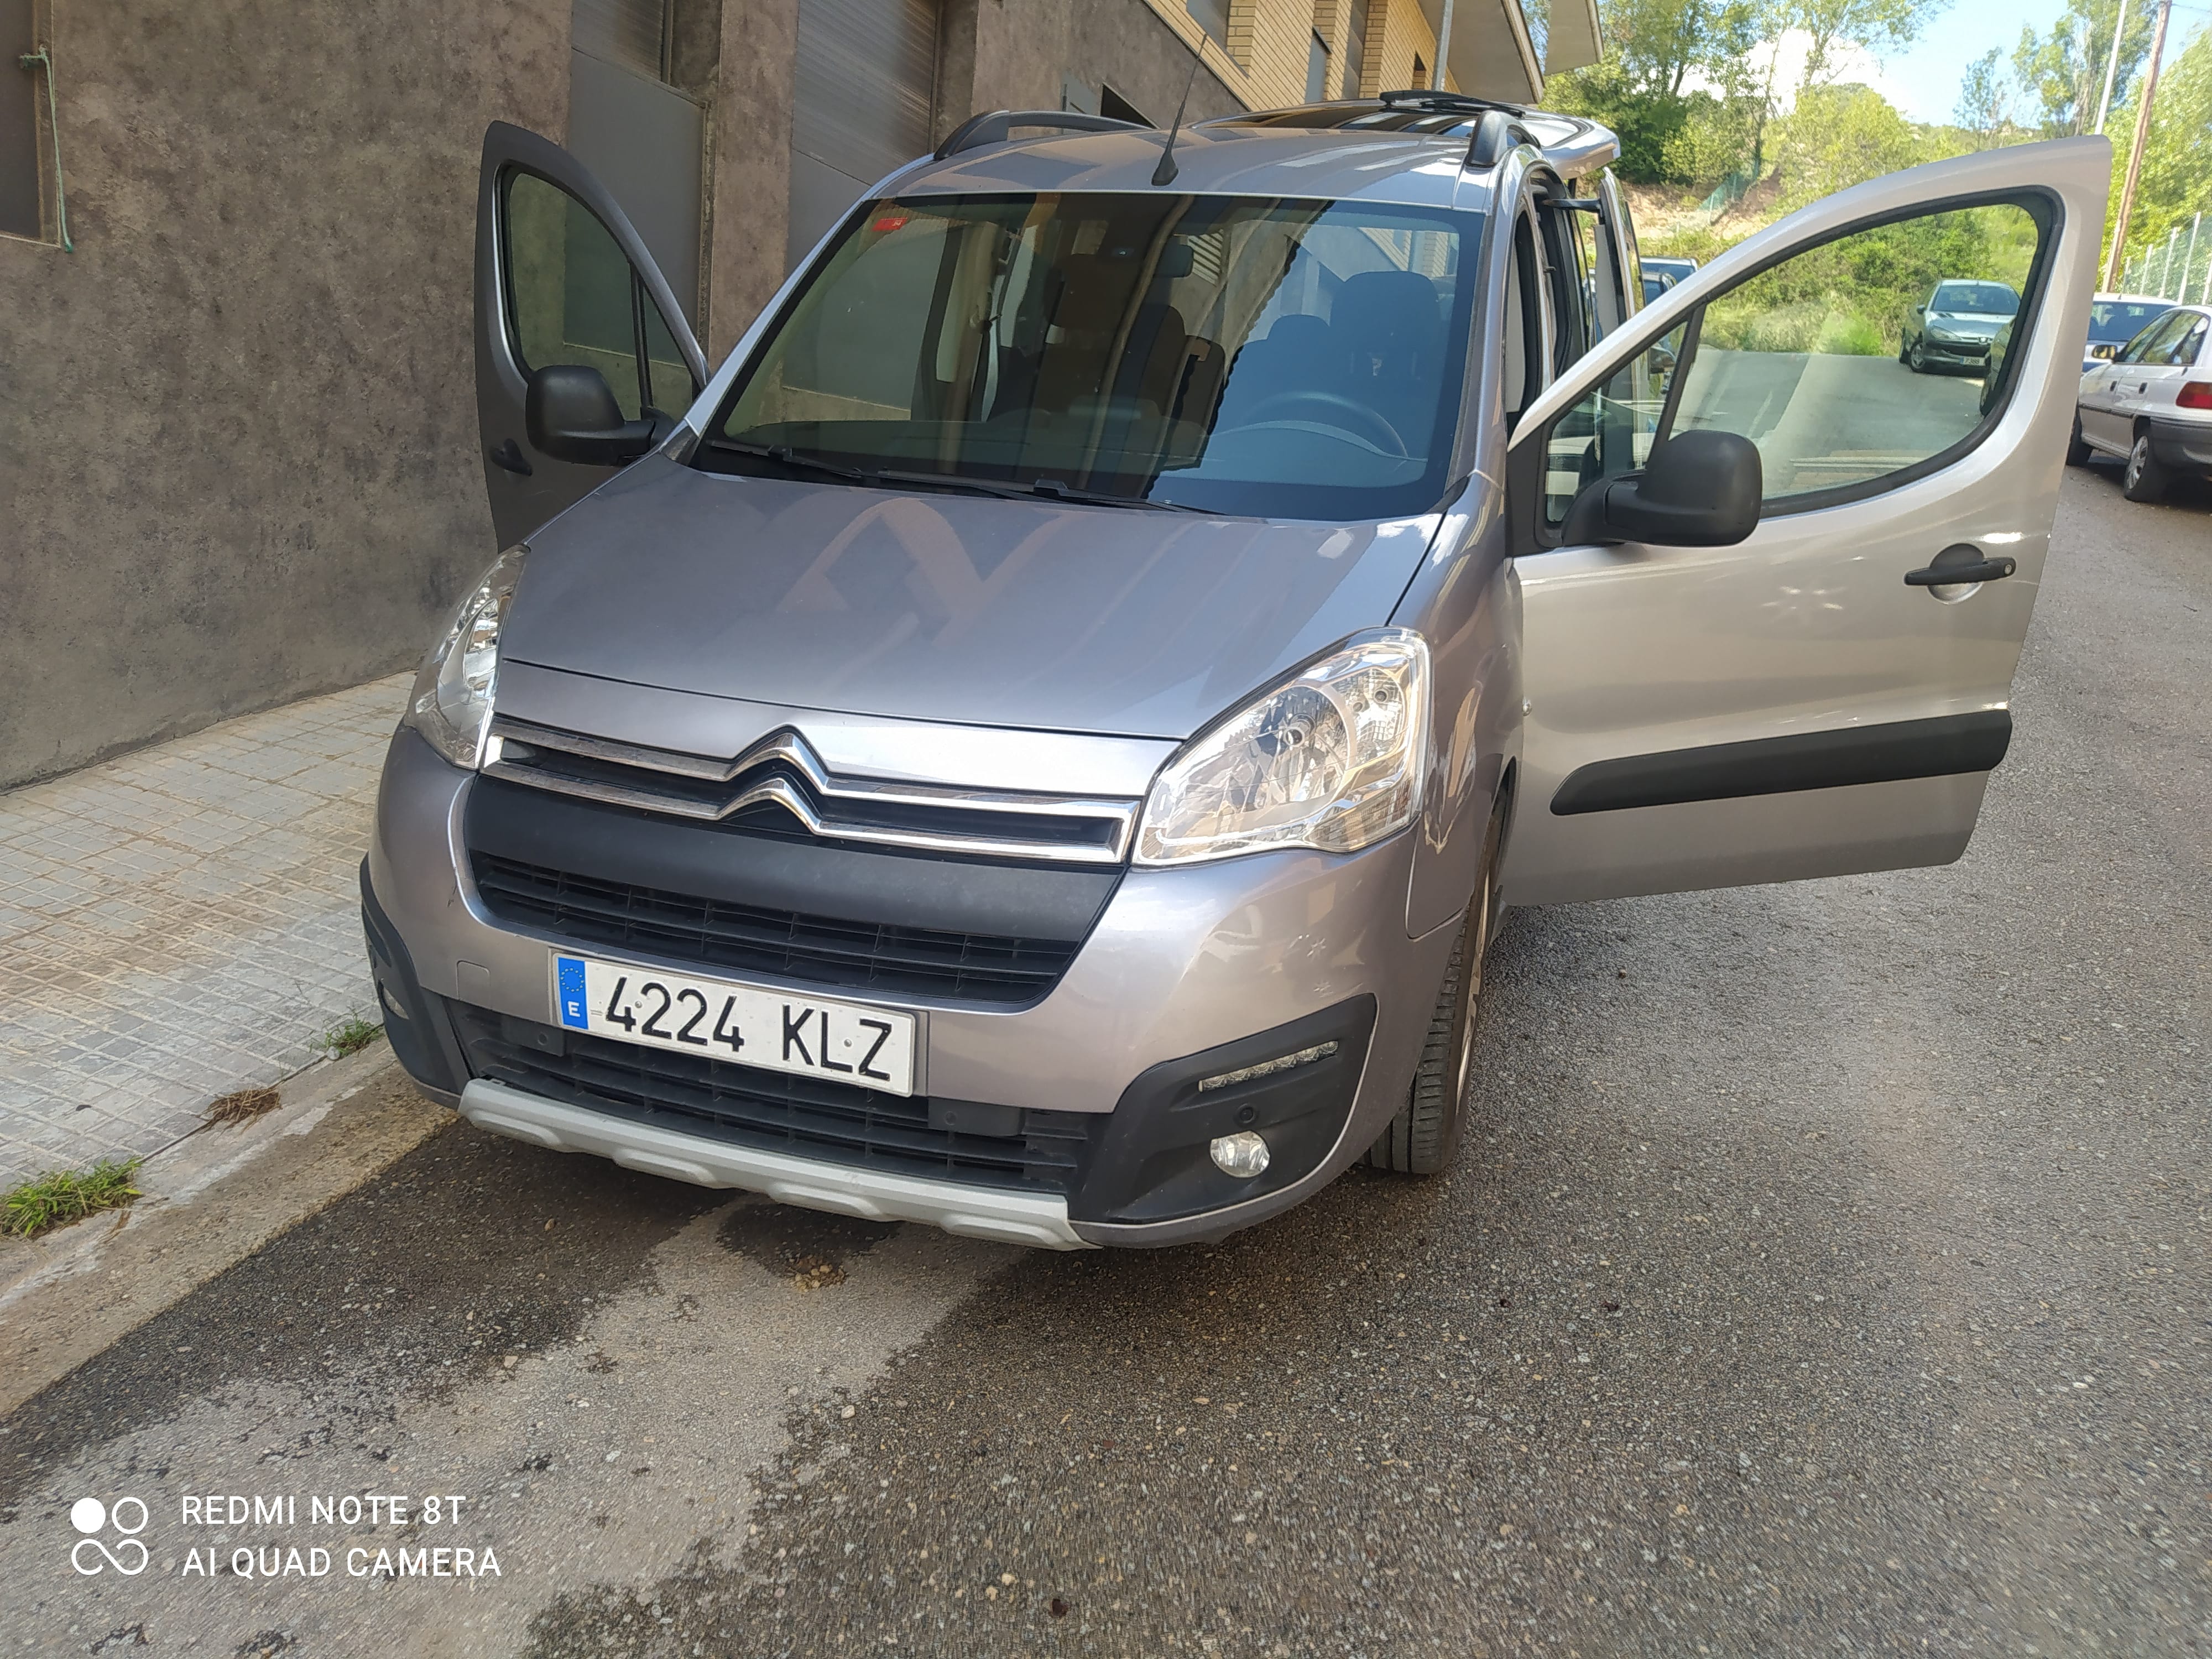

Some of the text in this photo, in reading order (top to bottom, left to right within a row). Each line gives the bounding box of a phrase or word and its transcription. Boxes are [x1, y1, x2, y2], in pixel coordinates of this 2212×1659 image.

[567, 1000, 581, 1018] E
[606, 977, 892, 1082] 4224 KLZ
